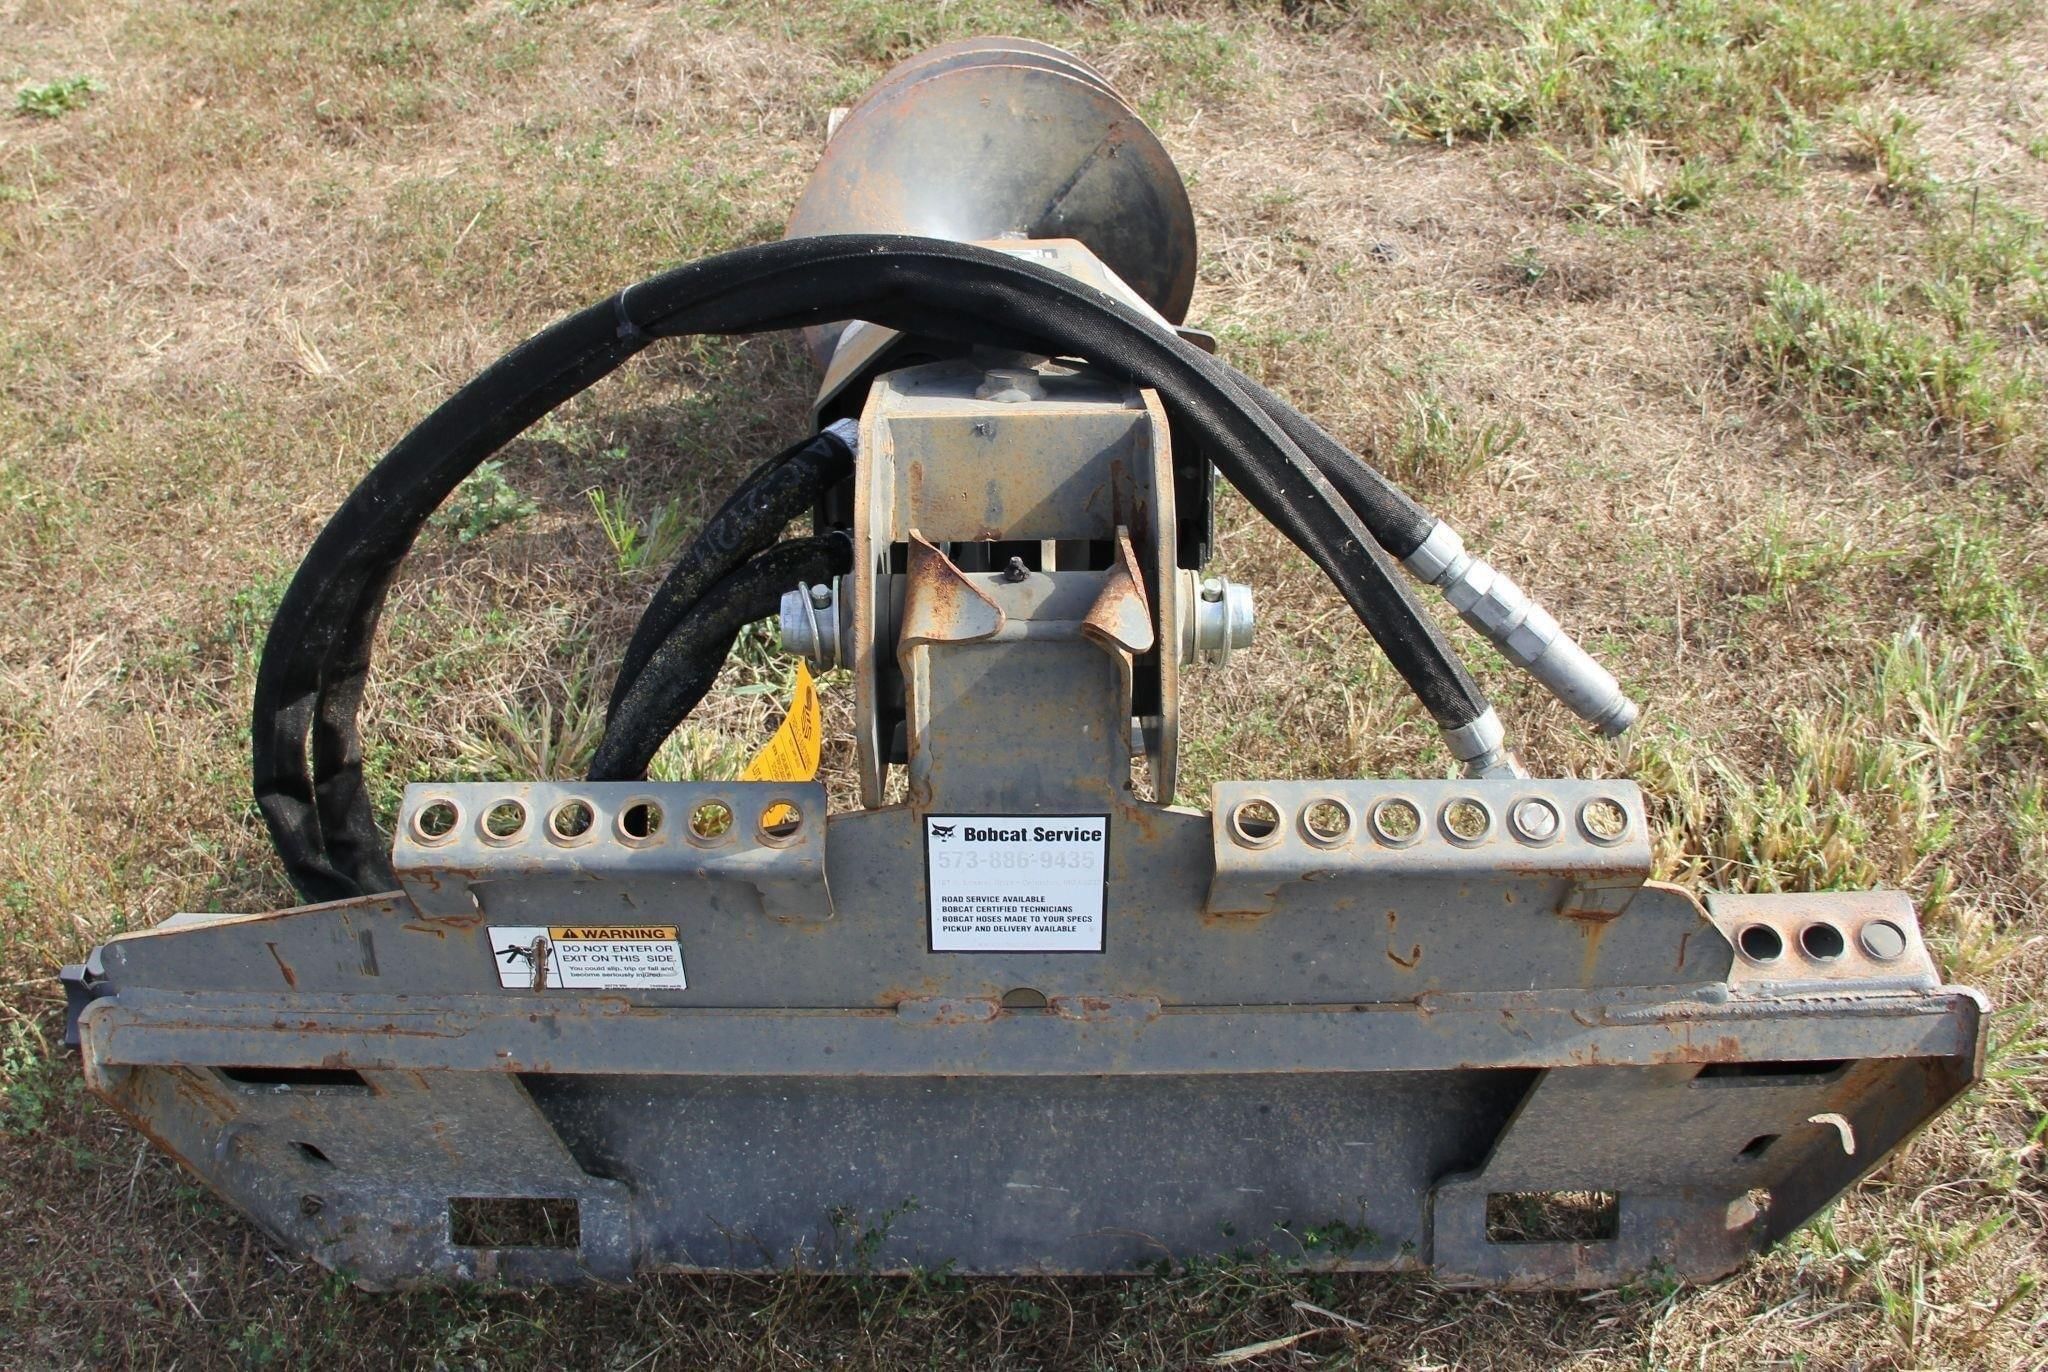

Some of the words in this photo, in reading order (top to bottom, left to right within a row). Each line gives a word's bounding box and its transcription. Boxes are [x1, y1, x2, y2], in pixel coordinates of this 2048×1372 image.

[964, 827, 1027, 842] Bobcat
[1033, 827, 1102, 842] Service
[938, 851, 1095, 869] 573-886-9435
[581, 929, 666, 939] WARNING
